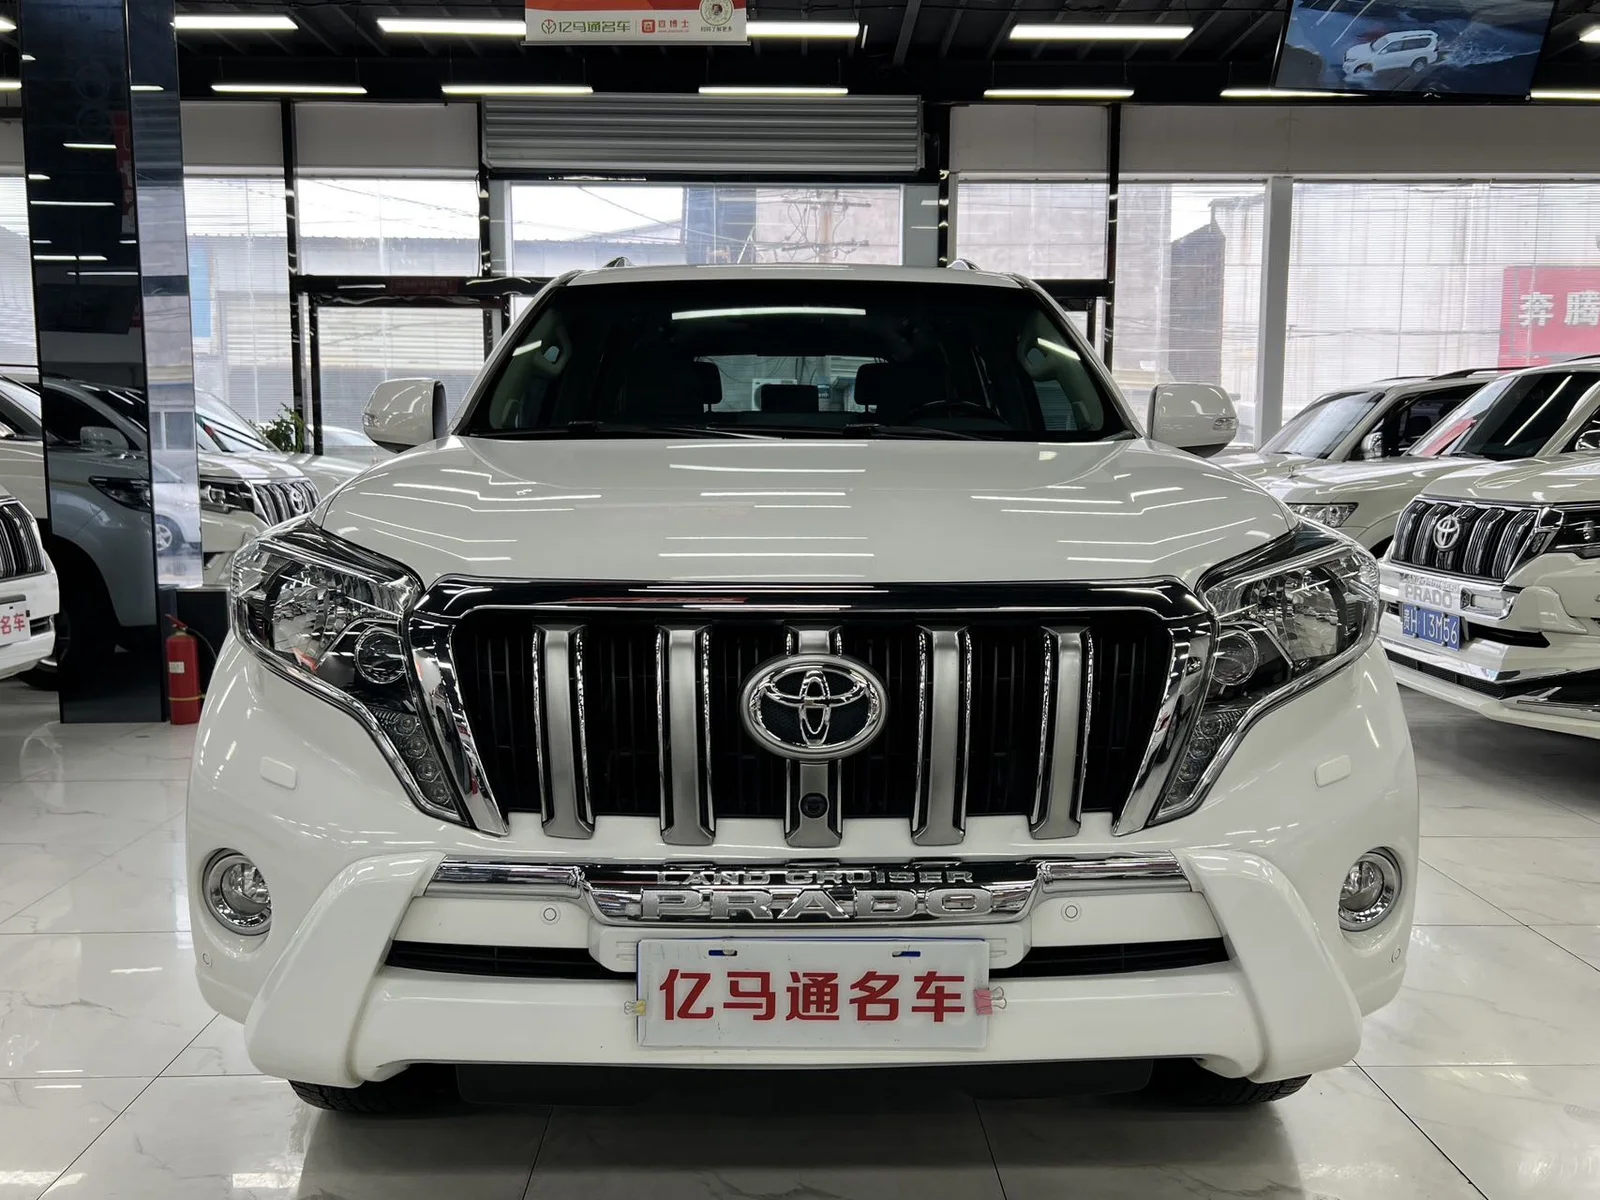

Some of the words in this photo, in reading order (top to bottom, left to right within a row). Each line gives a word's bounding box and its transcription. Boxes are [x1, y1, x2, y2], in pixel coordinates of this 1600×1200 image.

[558, 20, 631, 33] 亿马通名车
[1518, 290, 1600, 327] 奔腾
[1405, 584, 1453, 609] PRADO
[0, 612, 26, 635] 名车
[656, 870, 771, 885] LAND
[786, 869, 974, 885] CRUISER
[639, 887, 994, 920] PRADO
[658, 968, 967, 1024] 亿马通名车
